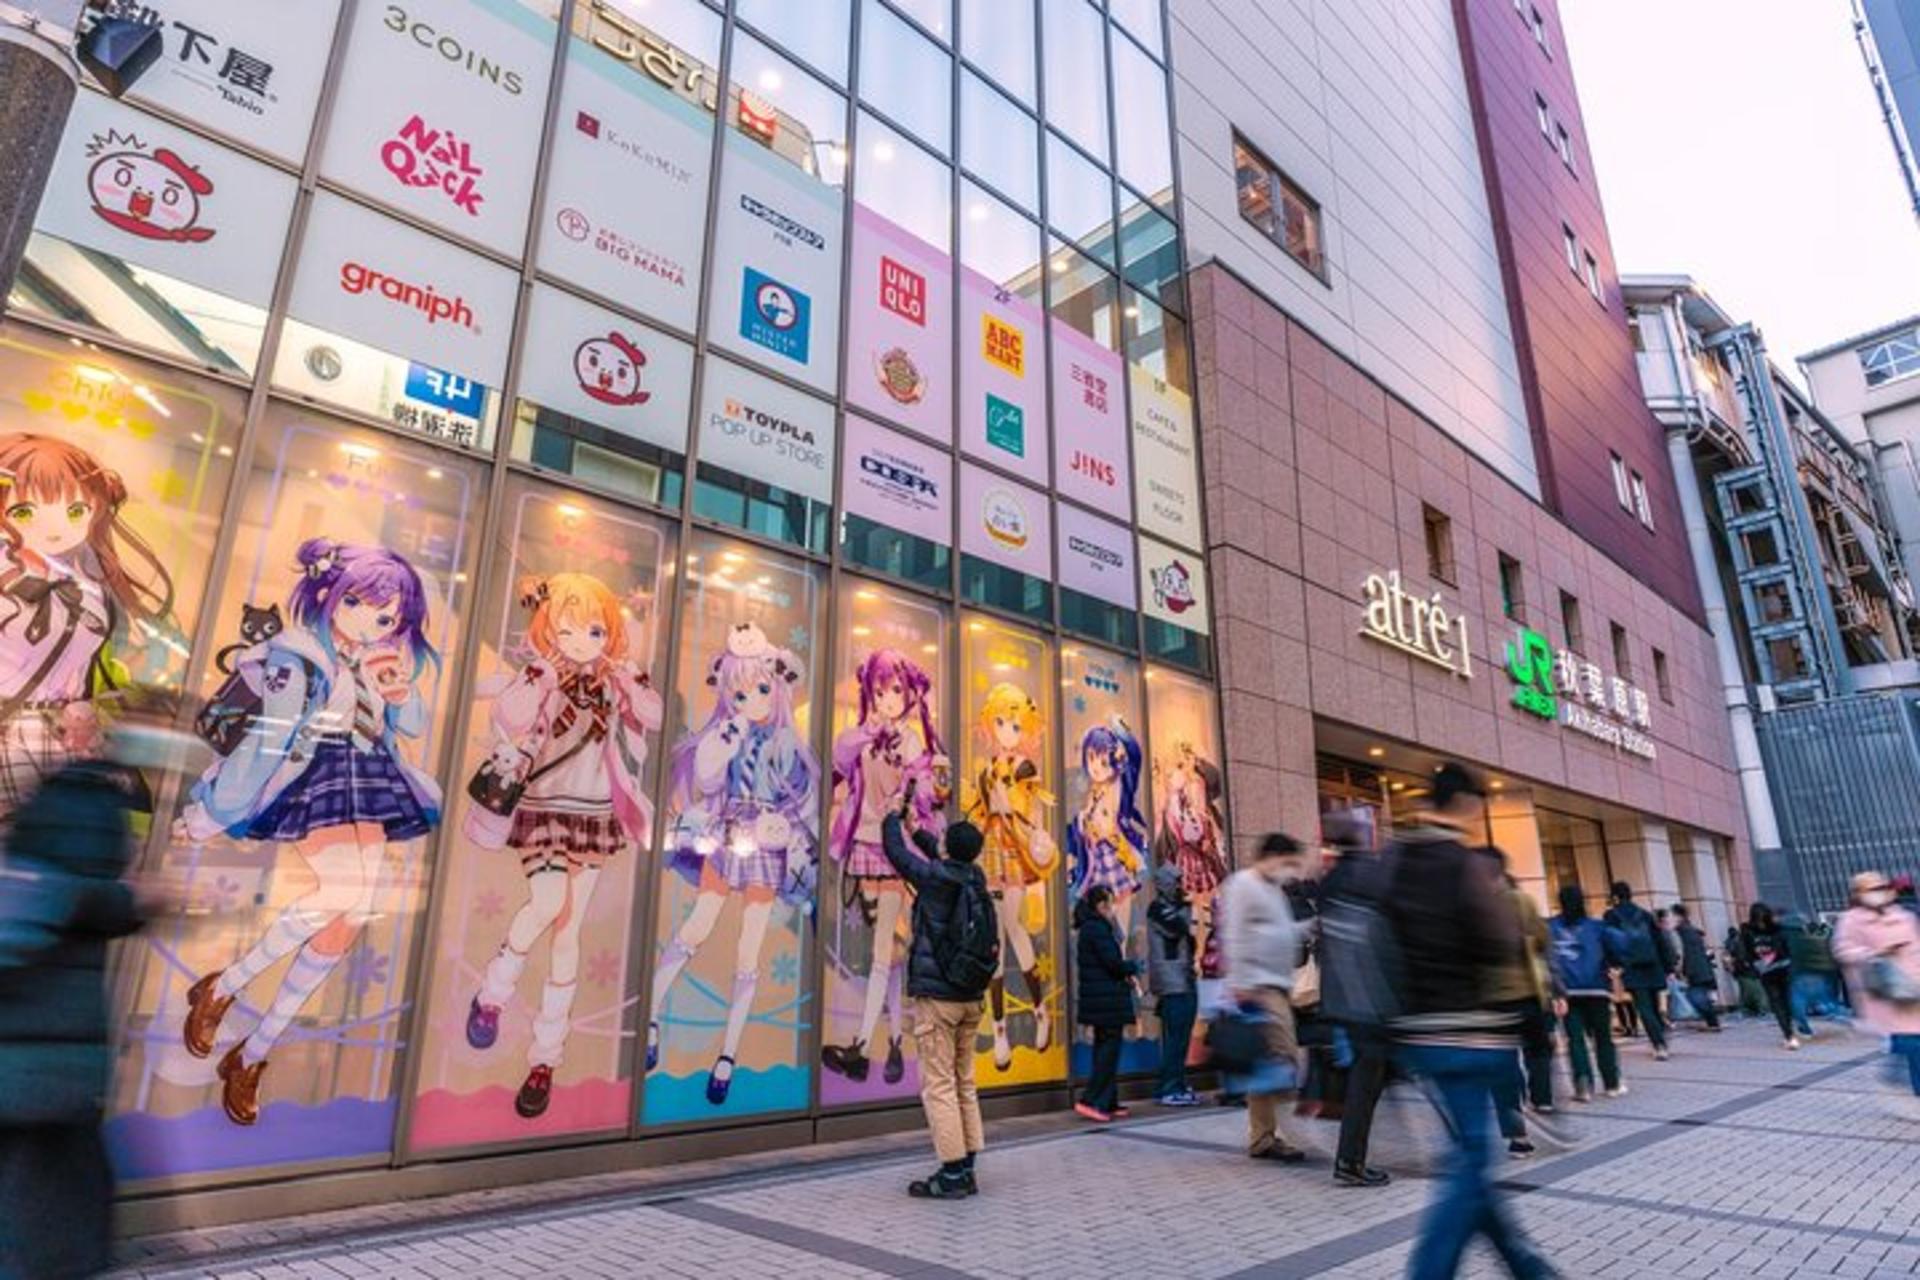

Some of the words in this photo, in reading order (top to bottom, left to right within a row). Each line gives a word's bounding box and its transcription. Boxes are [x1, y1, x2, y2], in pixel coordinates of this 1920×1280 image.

[383, 5, 523, 96] 3COINS
[595, 235, 630, 262] BIG
[634, 254, 685, 288] MAMA
[885, 263, 919, 299] UNI
[340, 262, 474, 328] graniph
[885, 286, 921, 319] QLO
[986, 321, 1022, 356] ABC
[710, 412, 747, 436] POP
[748, 427, 772, 447] UP
[775, 438, 825, 471] STORE
[743, 406, 816, 447] TOYPLA
[1070, 449, 1116, 487] JINS
[1506, 627, 1554, 695] JR
